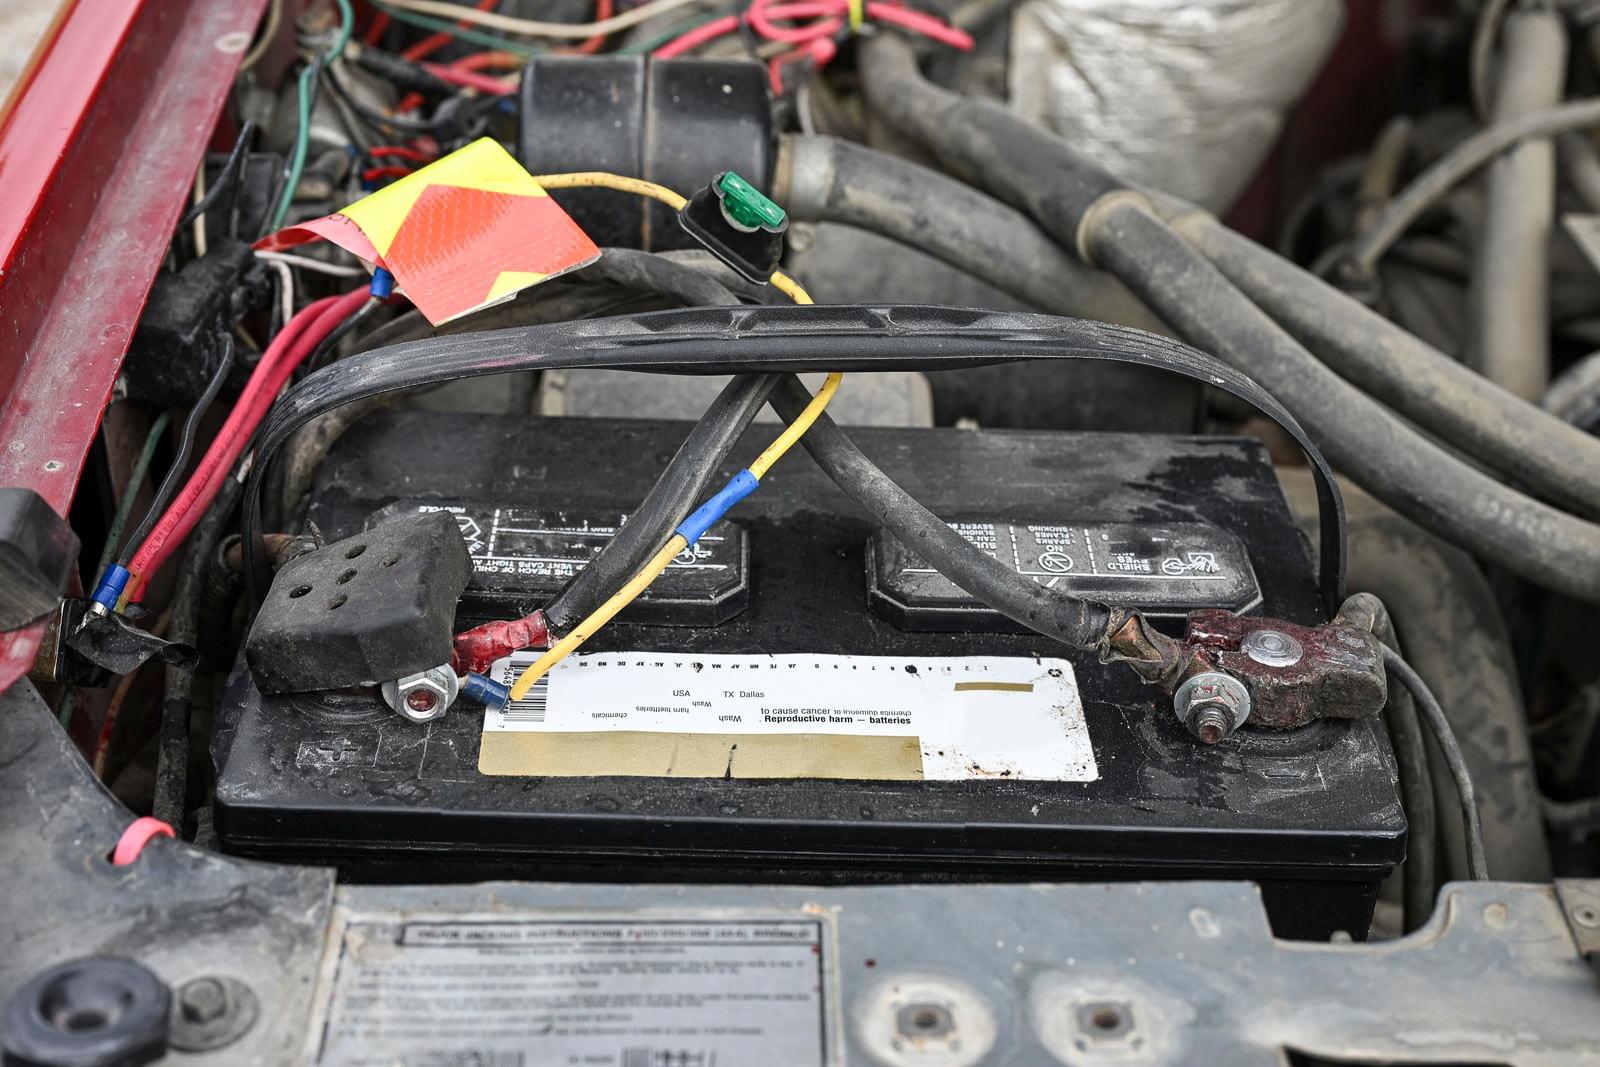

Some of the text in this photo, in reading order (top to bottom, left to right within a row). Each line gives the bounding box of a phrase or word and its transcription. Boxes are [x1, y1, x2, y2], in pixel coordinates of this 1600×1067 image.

[1045, 545, 1064, 553] NO
[485, 560, 514, 568] TIGHT
[1107, 562, 1151, 571] SHIELD
[500, 566, 514, 574] OF
[518, 567, 552, 575] REACH
[672, 689, 691, 697] USA
[723, 690, 765, 698] TX Dallas
[691, 700, 712, 708] Wash
[760, 707, 831, 716] to cause cancer
[591, 712, 628, 720] chemicals
[718, 715, 742, 723] Wash
[764, 715, 826, 724] Reproductive
[828, 715, 854, 724] harm
[869, 714, 912, 725] batteries
